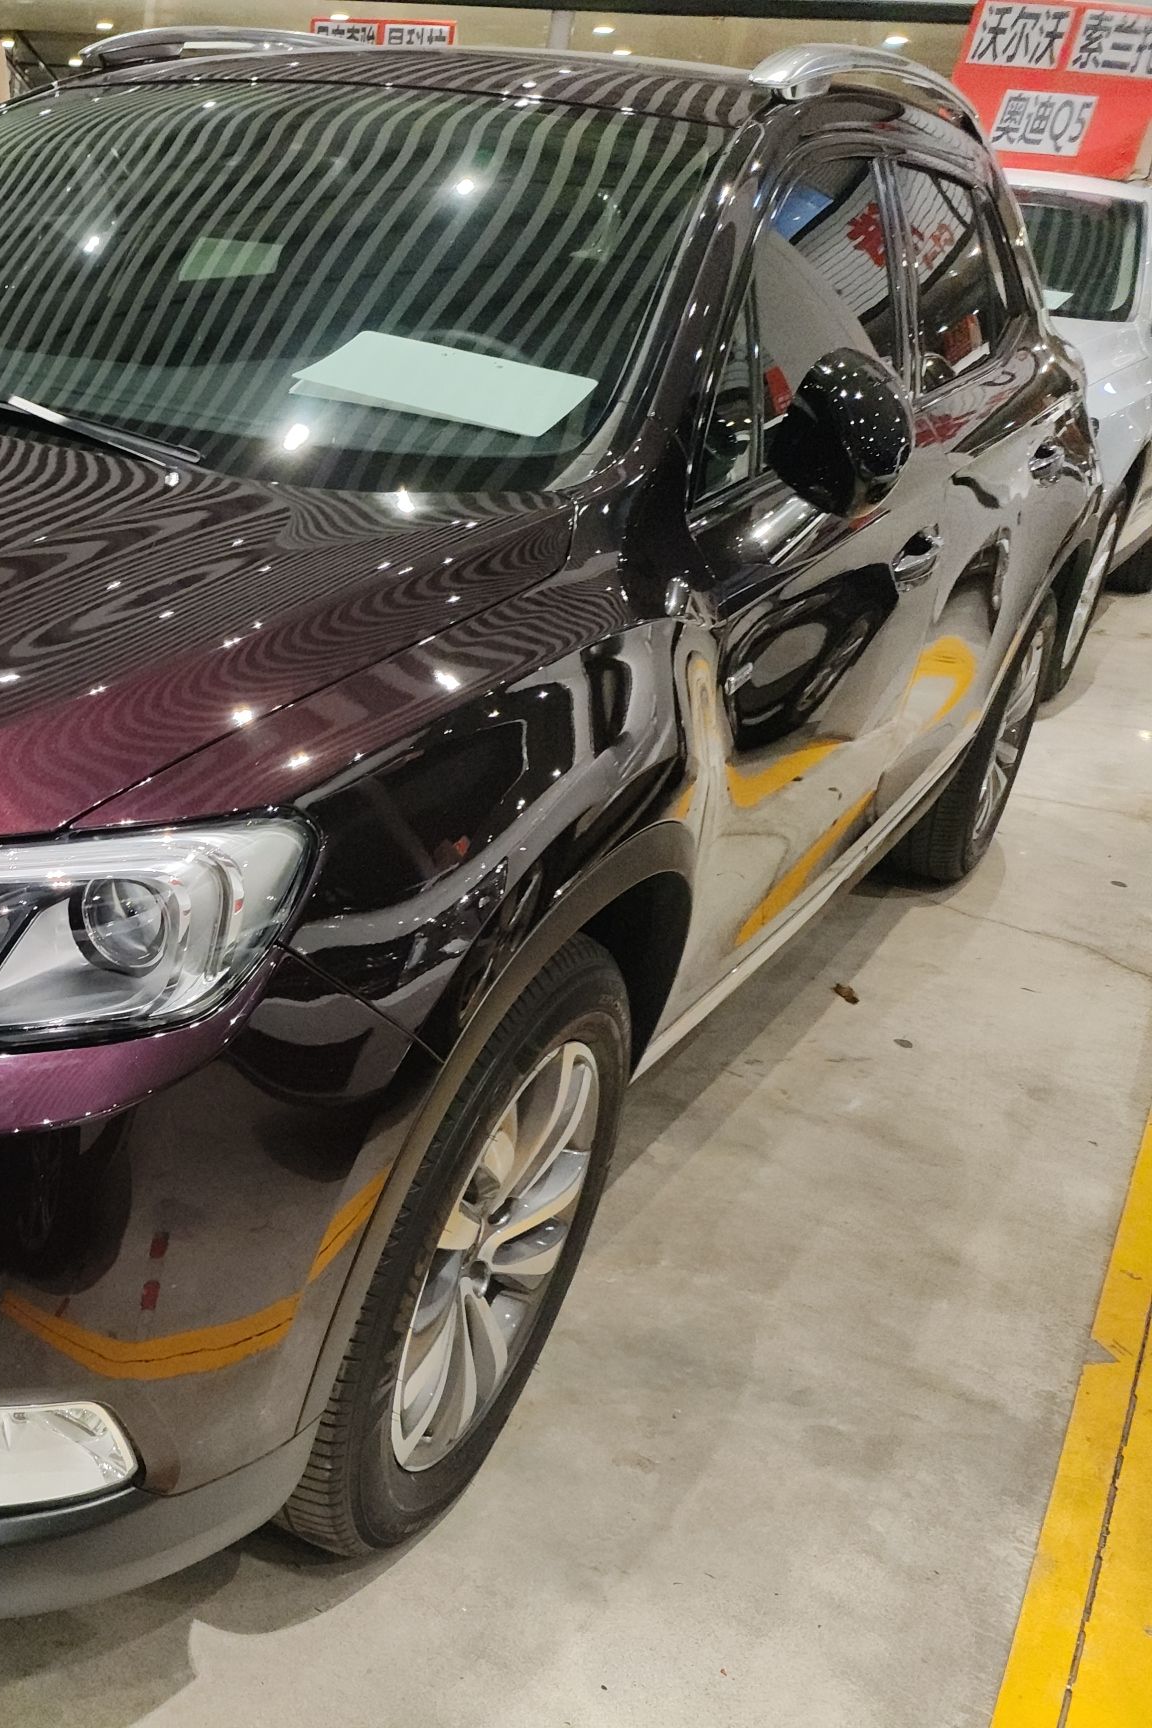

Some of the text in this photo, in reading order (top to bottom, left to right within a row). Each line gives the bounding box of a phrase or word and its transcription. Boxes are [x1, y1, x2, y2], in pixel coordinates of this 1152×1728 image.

[971, 6, 1072, 65] 沃尔沃
[991, 93, 1093, 153] 奥迪Q5
